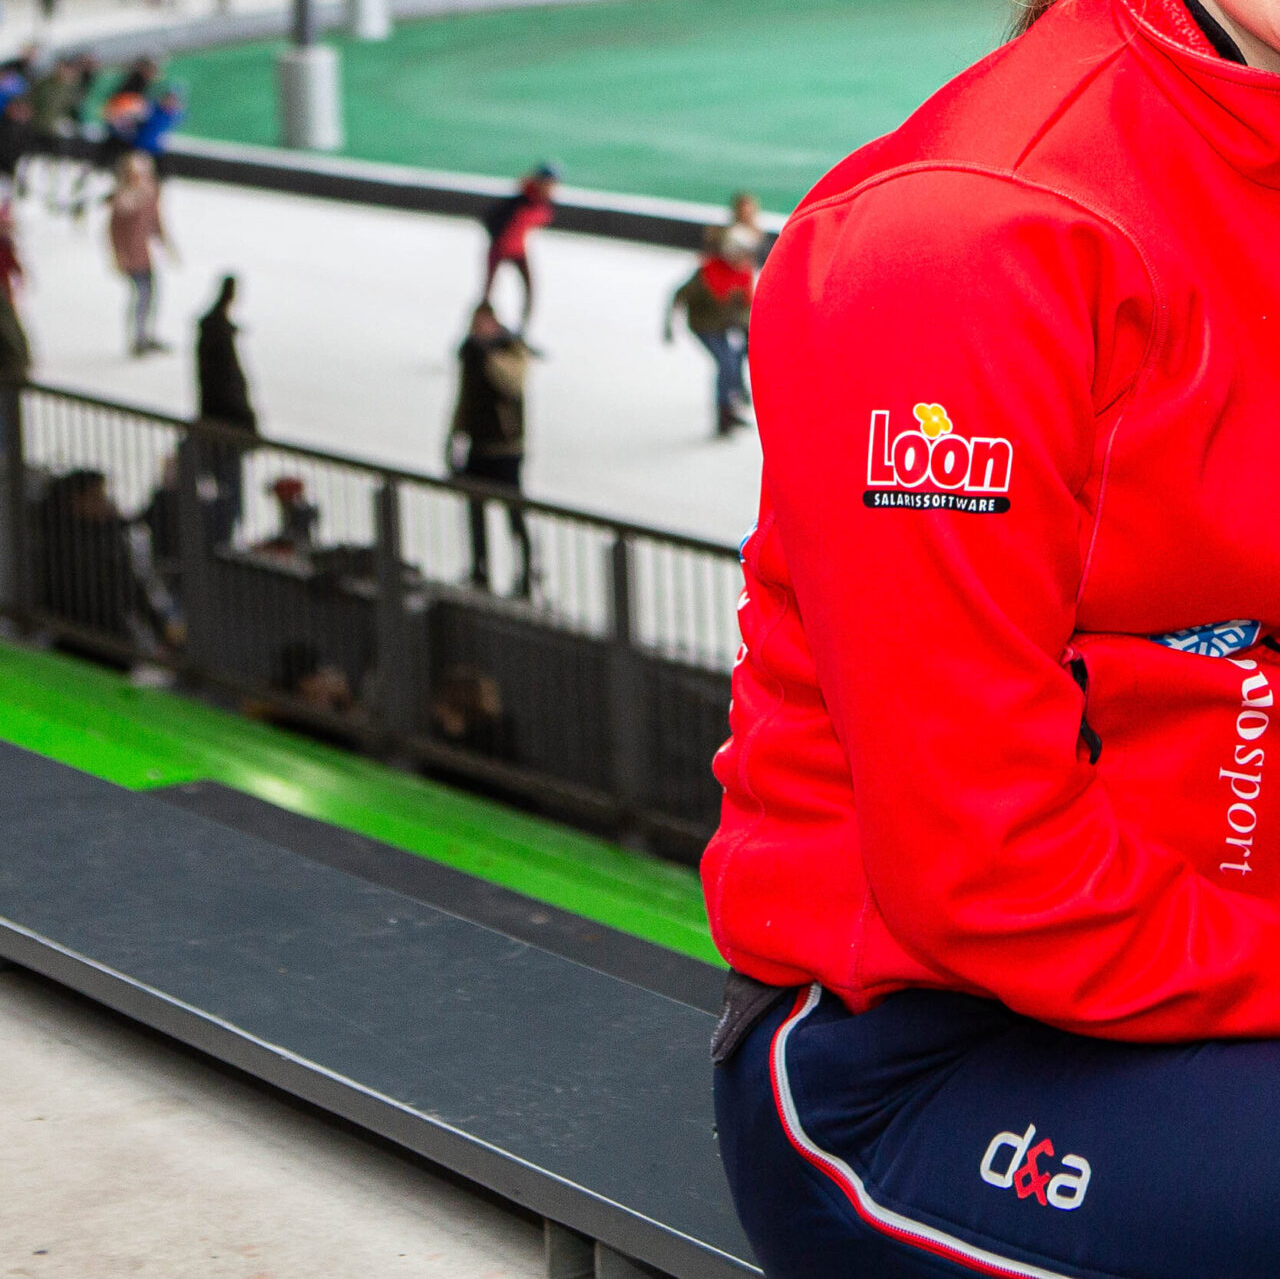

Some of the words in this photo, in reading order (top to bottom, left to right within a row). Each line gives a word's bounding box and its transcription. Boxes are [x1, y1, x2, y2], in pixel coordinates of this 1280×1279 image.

[867, 410, 1013, 492] Loon
[874, 493, 995, 512] SALARISSOFTWARE
[1219, 658, 1274, 876] uosport
[980, 1123, 1091, 1210] d&a
